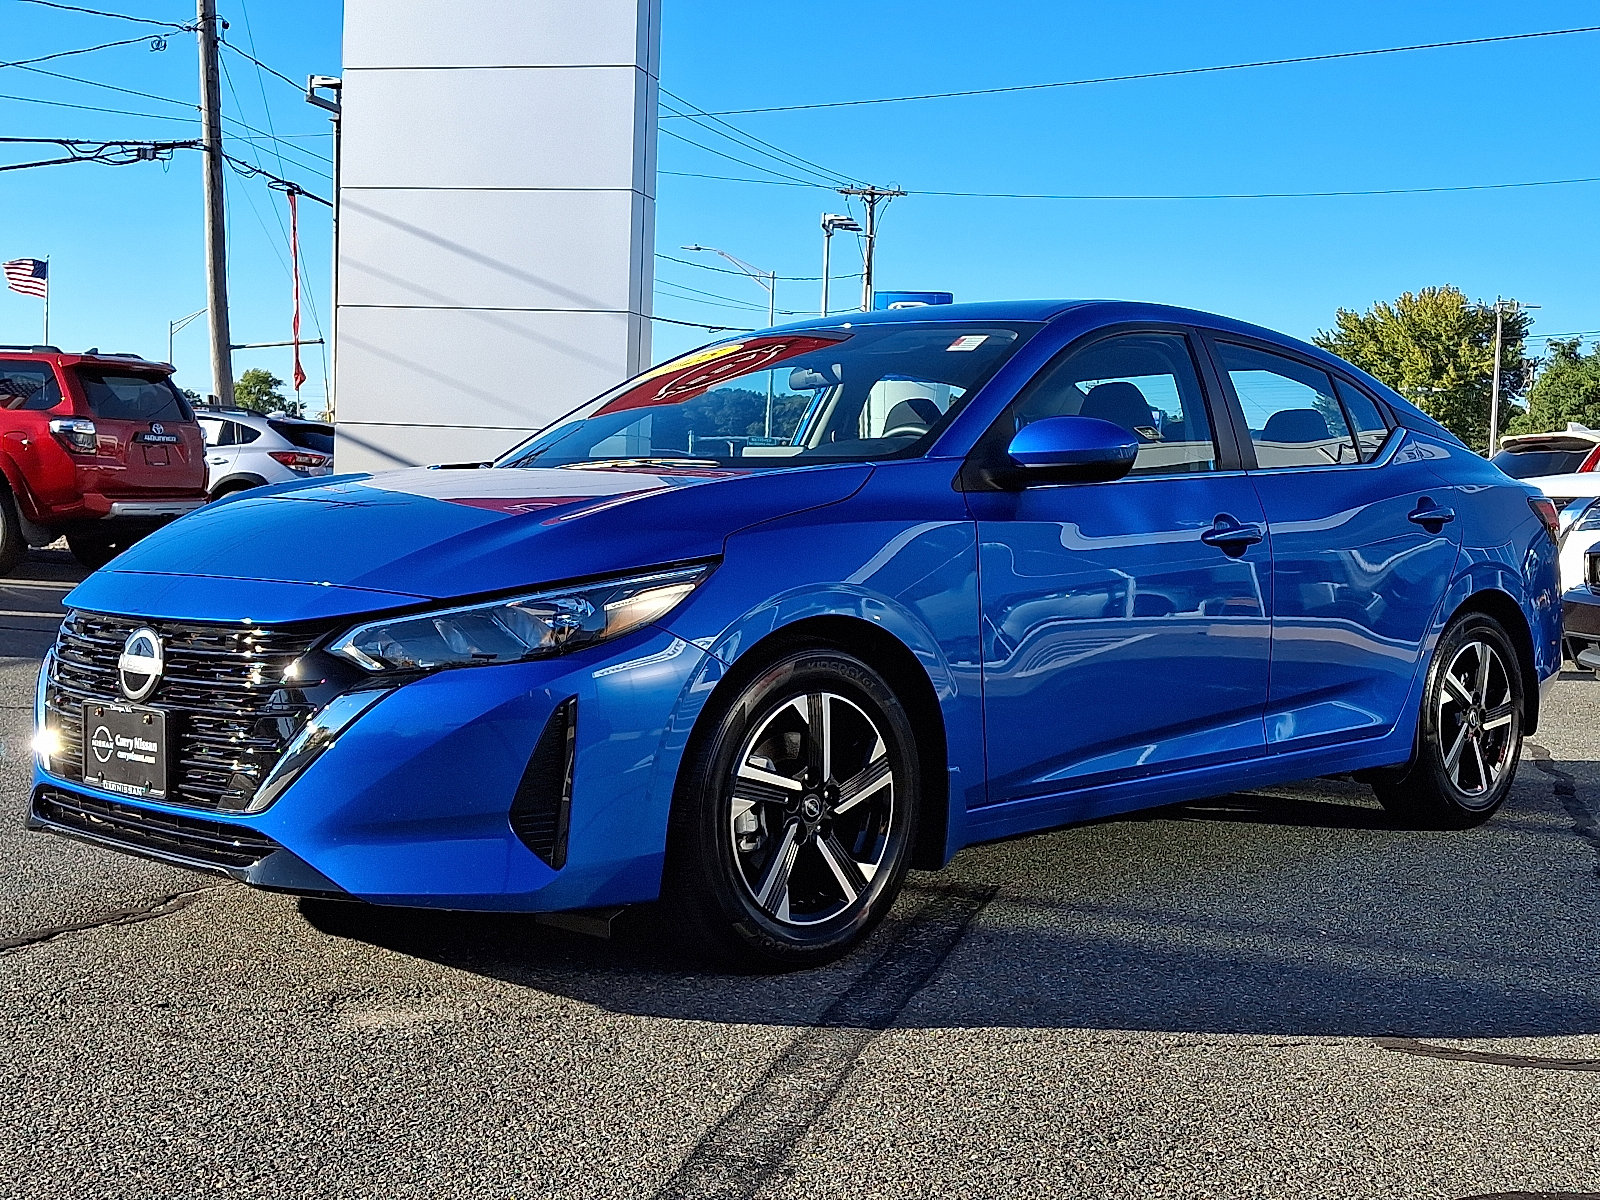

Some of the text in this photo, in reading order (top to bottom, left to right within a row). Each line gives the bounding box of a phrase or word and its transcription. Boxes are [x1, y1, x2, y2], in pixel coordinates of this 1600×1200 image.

[91, 739, 114, 750] NISSAN
[115, 733, 158, 752] Curry Nissan
